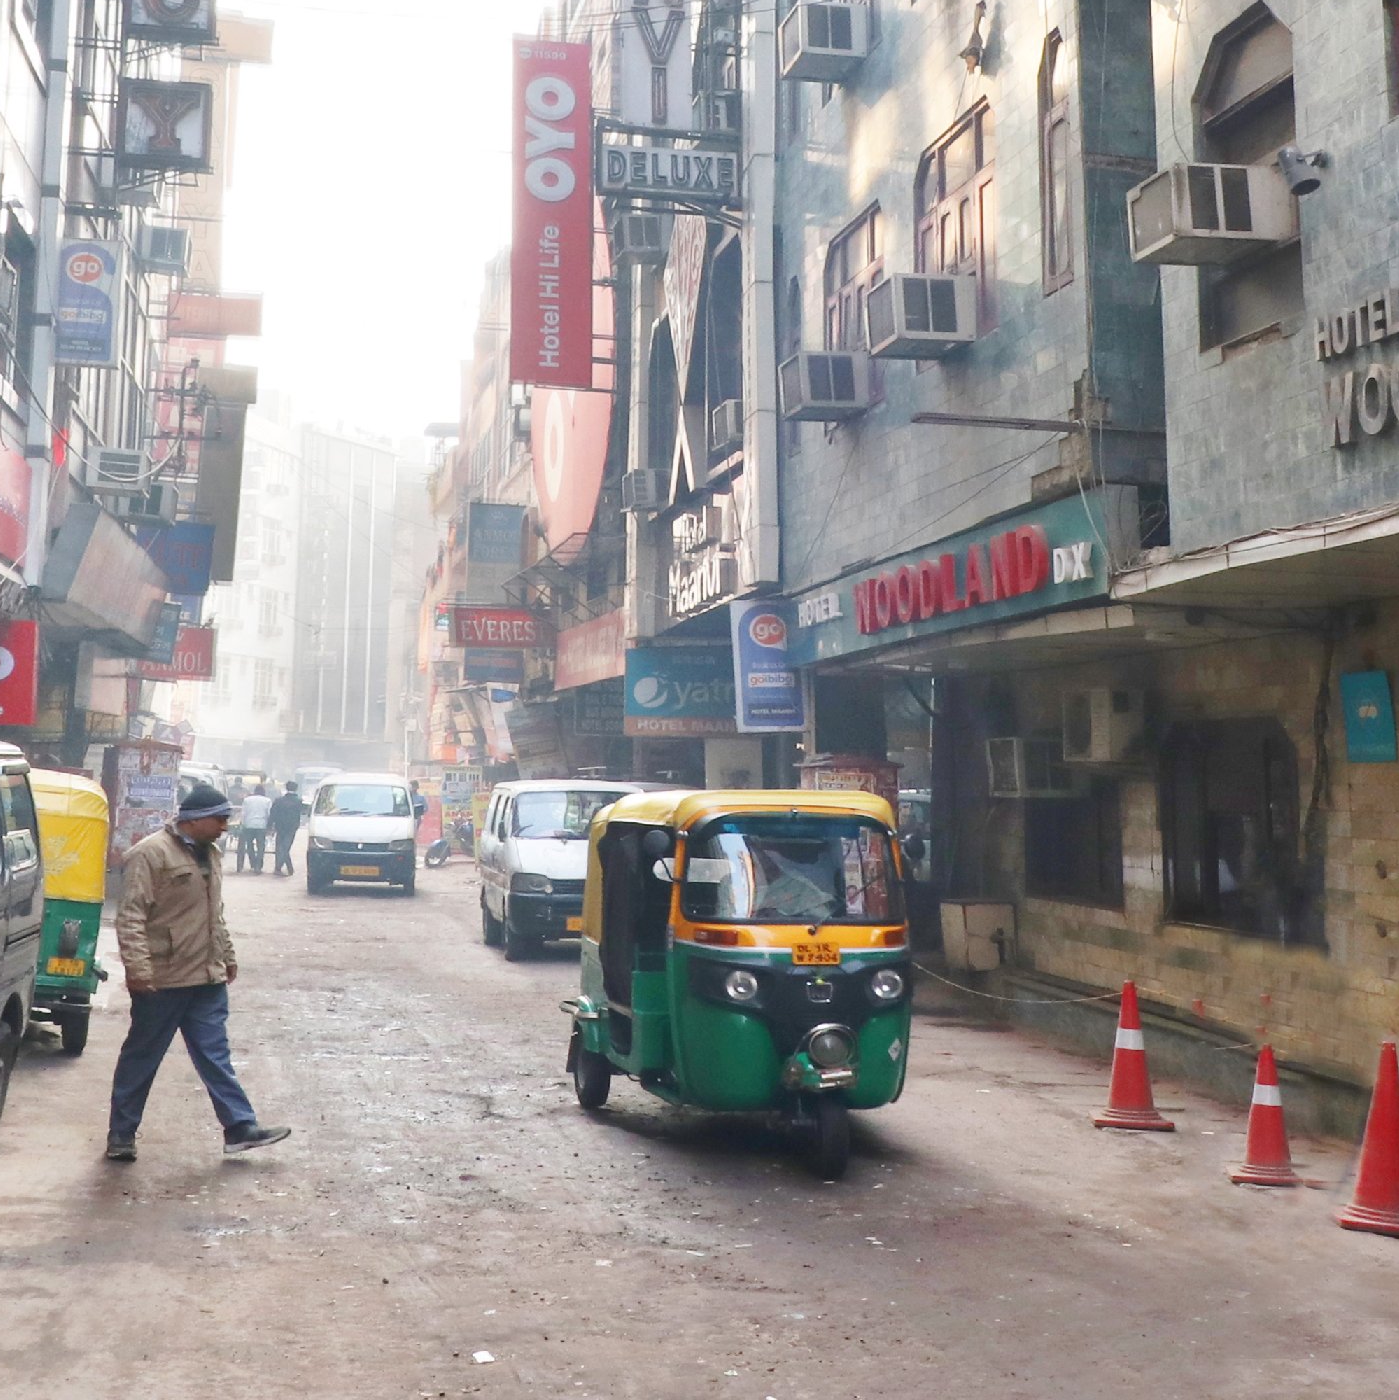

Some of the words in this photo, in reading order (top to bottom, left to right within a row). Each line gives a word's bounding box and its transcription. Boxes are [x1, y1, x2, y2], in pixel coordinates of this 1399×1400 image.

[525, 75, 576, 203] OYO
[608, 147, 736, 190] DELUXE
[538, 225, 559, 261] Life
[72, 261, 98, 277] go
[539, 268, 559, 299] Hi
[539, 306, 559, 369] Hotel
[798, 591, 842, 629] HOTEL
[852, 523, 1050, 636] WOODLAND
[1053, 541, 1094, 585] DX
[755, 622, 781, 639] go
[637, 719, 687, 733] HOTEL
